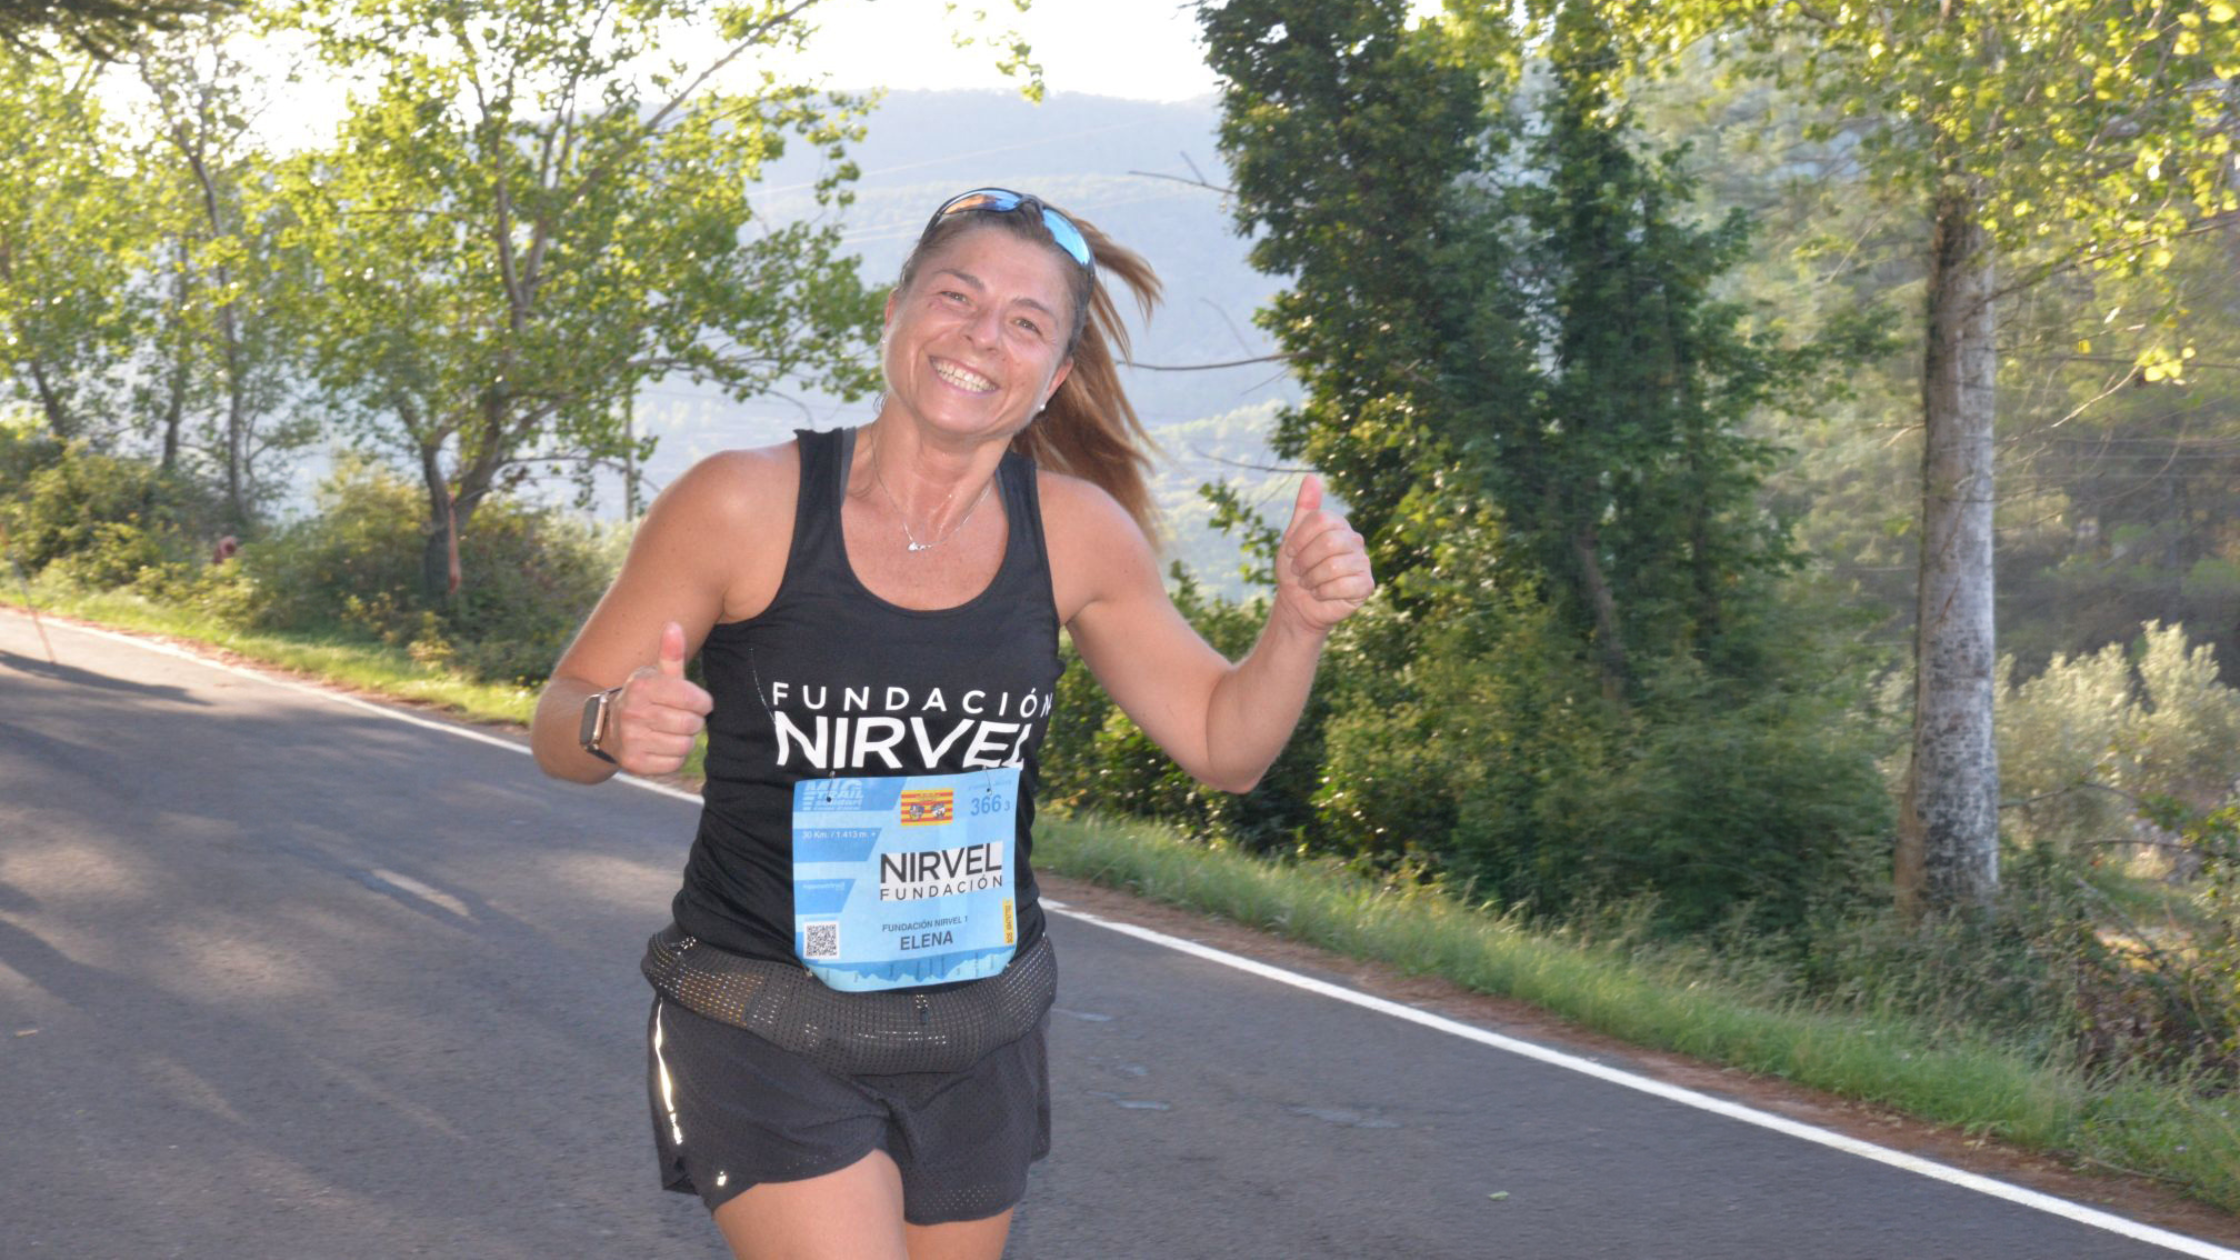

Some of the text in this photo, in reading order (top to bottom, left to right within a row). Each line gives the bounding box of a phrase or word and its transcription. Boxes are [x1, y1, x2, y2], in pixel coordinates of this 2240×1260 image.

[772, 681, 1054, 718] FUNDACIÓN
[774, 711, 1032, 770] NIRVEL
[970, 794, 1002, 816] 366
[880, 843, 1002, 884] NIRVEL
[880, 874, 1003, 901] FUNDACIÓN
[882, 919, 933, 932] FUNDACIÓN
[934, 916, 962, 927] NIRVEL
[900, 930, 954, 951] ELENA
